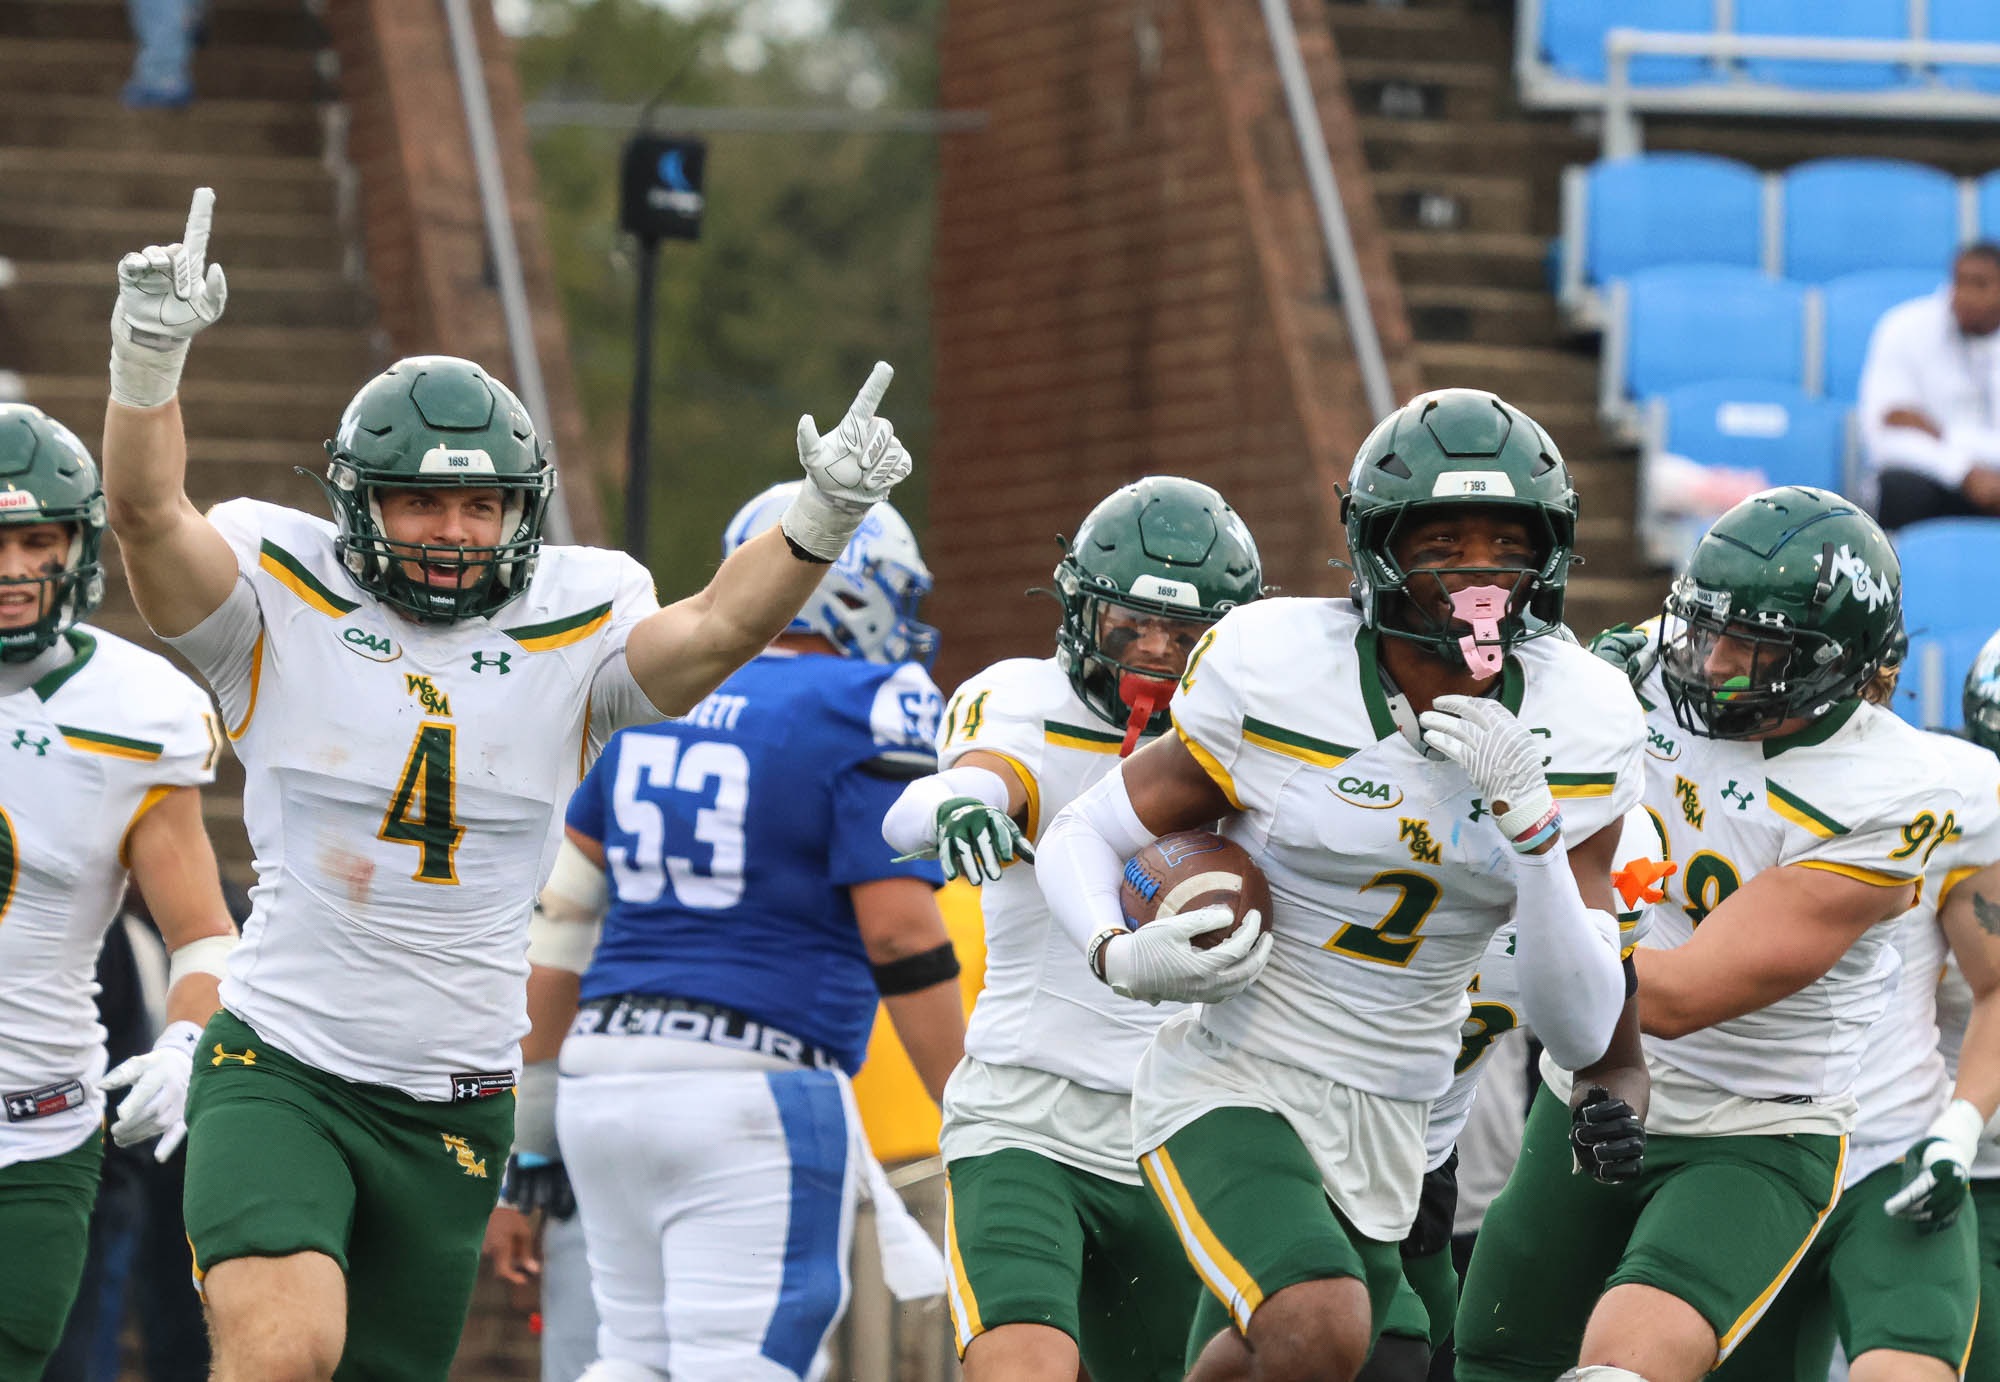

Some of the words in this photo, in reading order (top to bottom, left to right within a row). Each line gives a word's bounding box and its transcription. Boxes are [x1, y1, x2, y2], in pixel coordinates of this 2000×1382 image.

[447, 456, 469, 467] 1693
[1157, 585, 1178, 598] 1693
[343, 627, 391, 655] CAA
[403, 672, 453, 718] W&M
[942, 689, 993, 752] 14
[376, 720, 468, 886] 4
[1338, 776, 1390, 801] CAA
[1675, 773, 1706, 832] W&M
[607, 731, 750, 910] 53
[1398, 816, 1442, 866] W&M
[1320, 869, 1443, 968] 2
